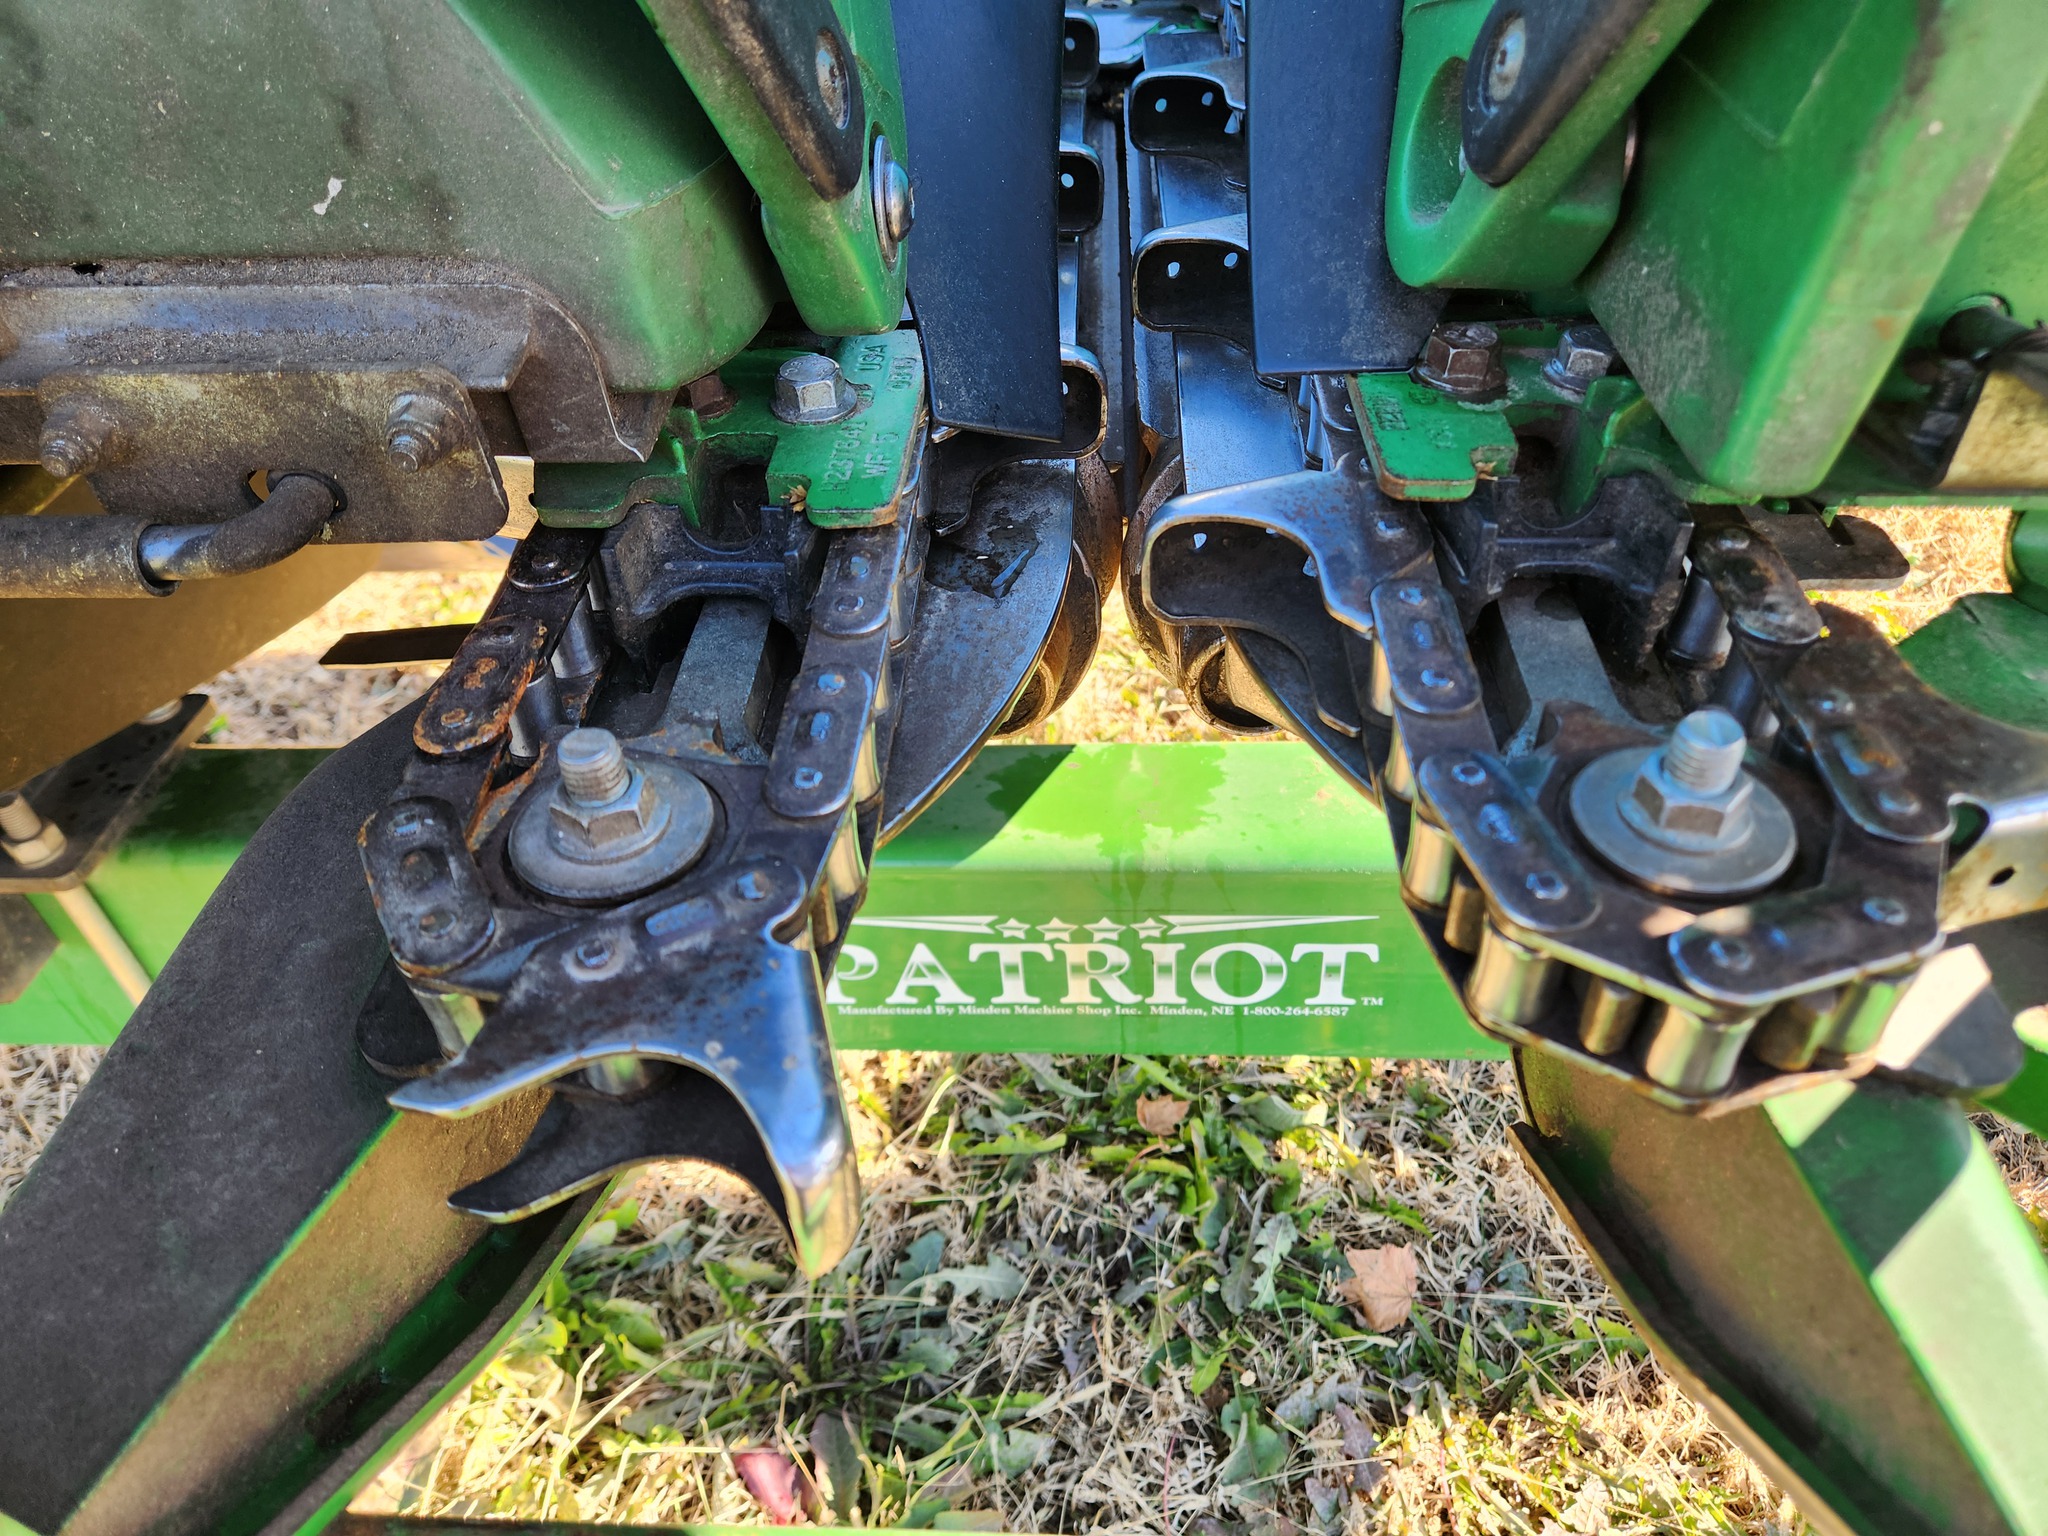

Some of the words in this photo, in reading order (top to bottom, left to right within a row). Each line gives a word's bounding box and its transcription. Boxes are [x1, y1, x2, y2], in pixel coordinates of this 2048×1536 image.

[857, 344, 888, 372] USA
[826, 942, 1380, 1004] PATRIOT
[838, 1004, 932, 1015] Manufactured
[935, 1004, 954, 1016] By
[958, 1004, 1011, 1015] Minden
[1014, 1004, 1073, 1015] Machine
[1076, 1004, 1111, 1017] Shop
[1114, 1004, 1142, 1015] Inc.
[1149, 1005, 1208, 1017] Minden,
[1211, 1005, 1234, 1015] NE
[1243, 1006, 1349, 1016] 1-800-264-6587
